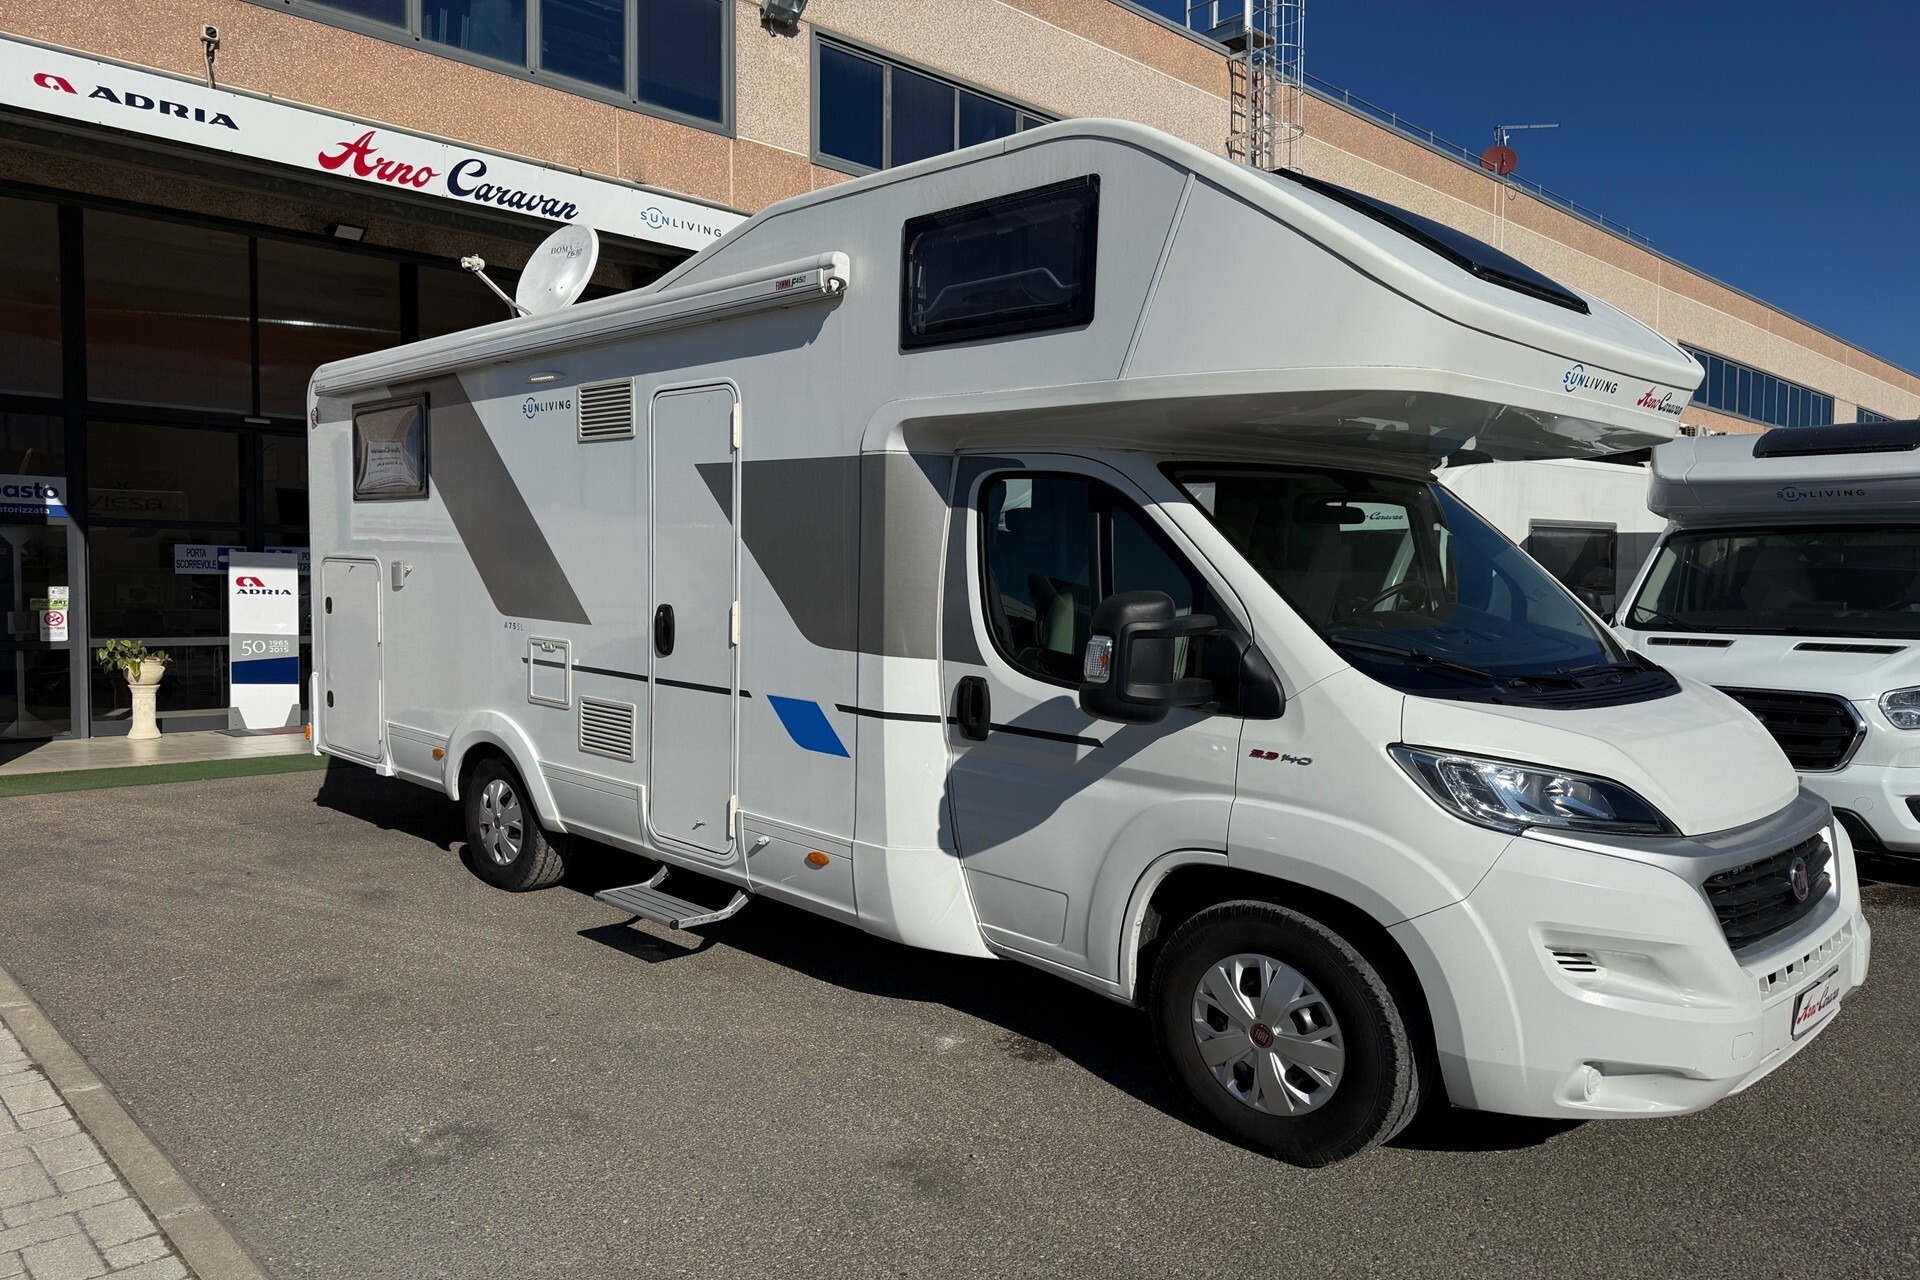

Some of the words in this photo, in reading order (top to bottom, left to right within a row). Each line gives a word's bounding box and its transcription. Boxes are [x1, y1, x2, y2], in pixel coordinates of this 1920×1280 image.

[88, 85, 240, 131] ADRIA
[318, 130, 441, 188] Arno
[447, 158, 579, 220] Caravan
[640, 209, 723, 238] SUNLIVING
[1563, 367, 1618, 394] SUNLIVING
[1636, 385, 1659, 410] Arno
[522, 398, 571, 416] SUNLIVING
[0, 482, 59, 499] asto
[1776, 488, 1866, 500] SUNLIVING
[186, 548, 207, 558] PORTA
[176, 559, 217, 569] SCORREVOLE
[241, 640, 266, 656] 50
[1254, 1028, 1269, 1043] FIAT
